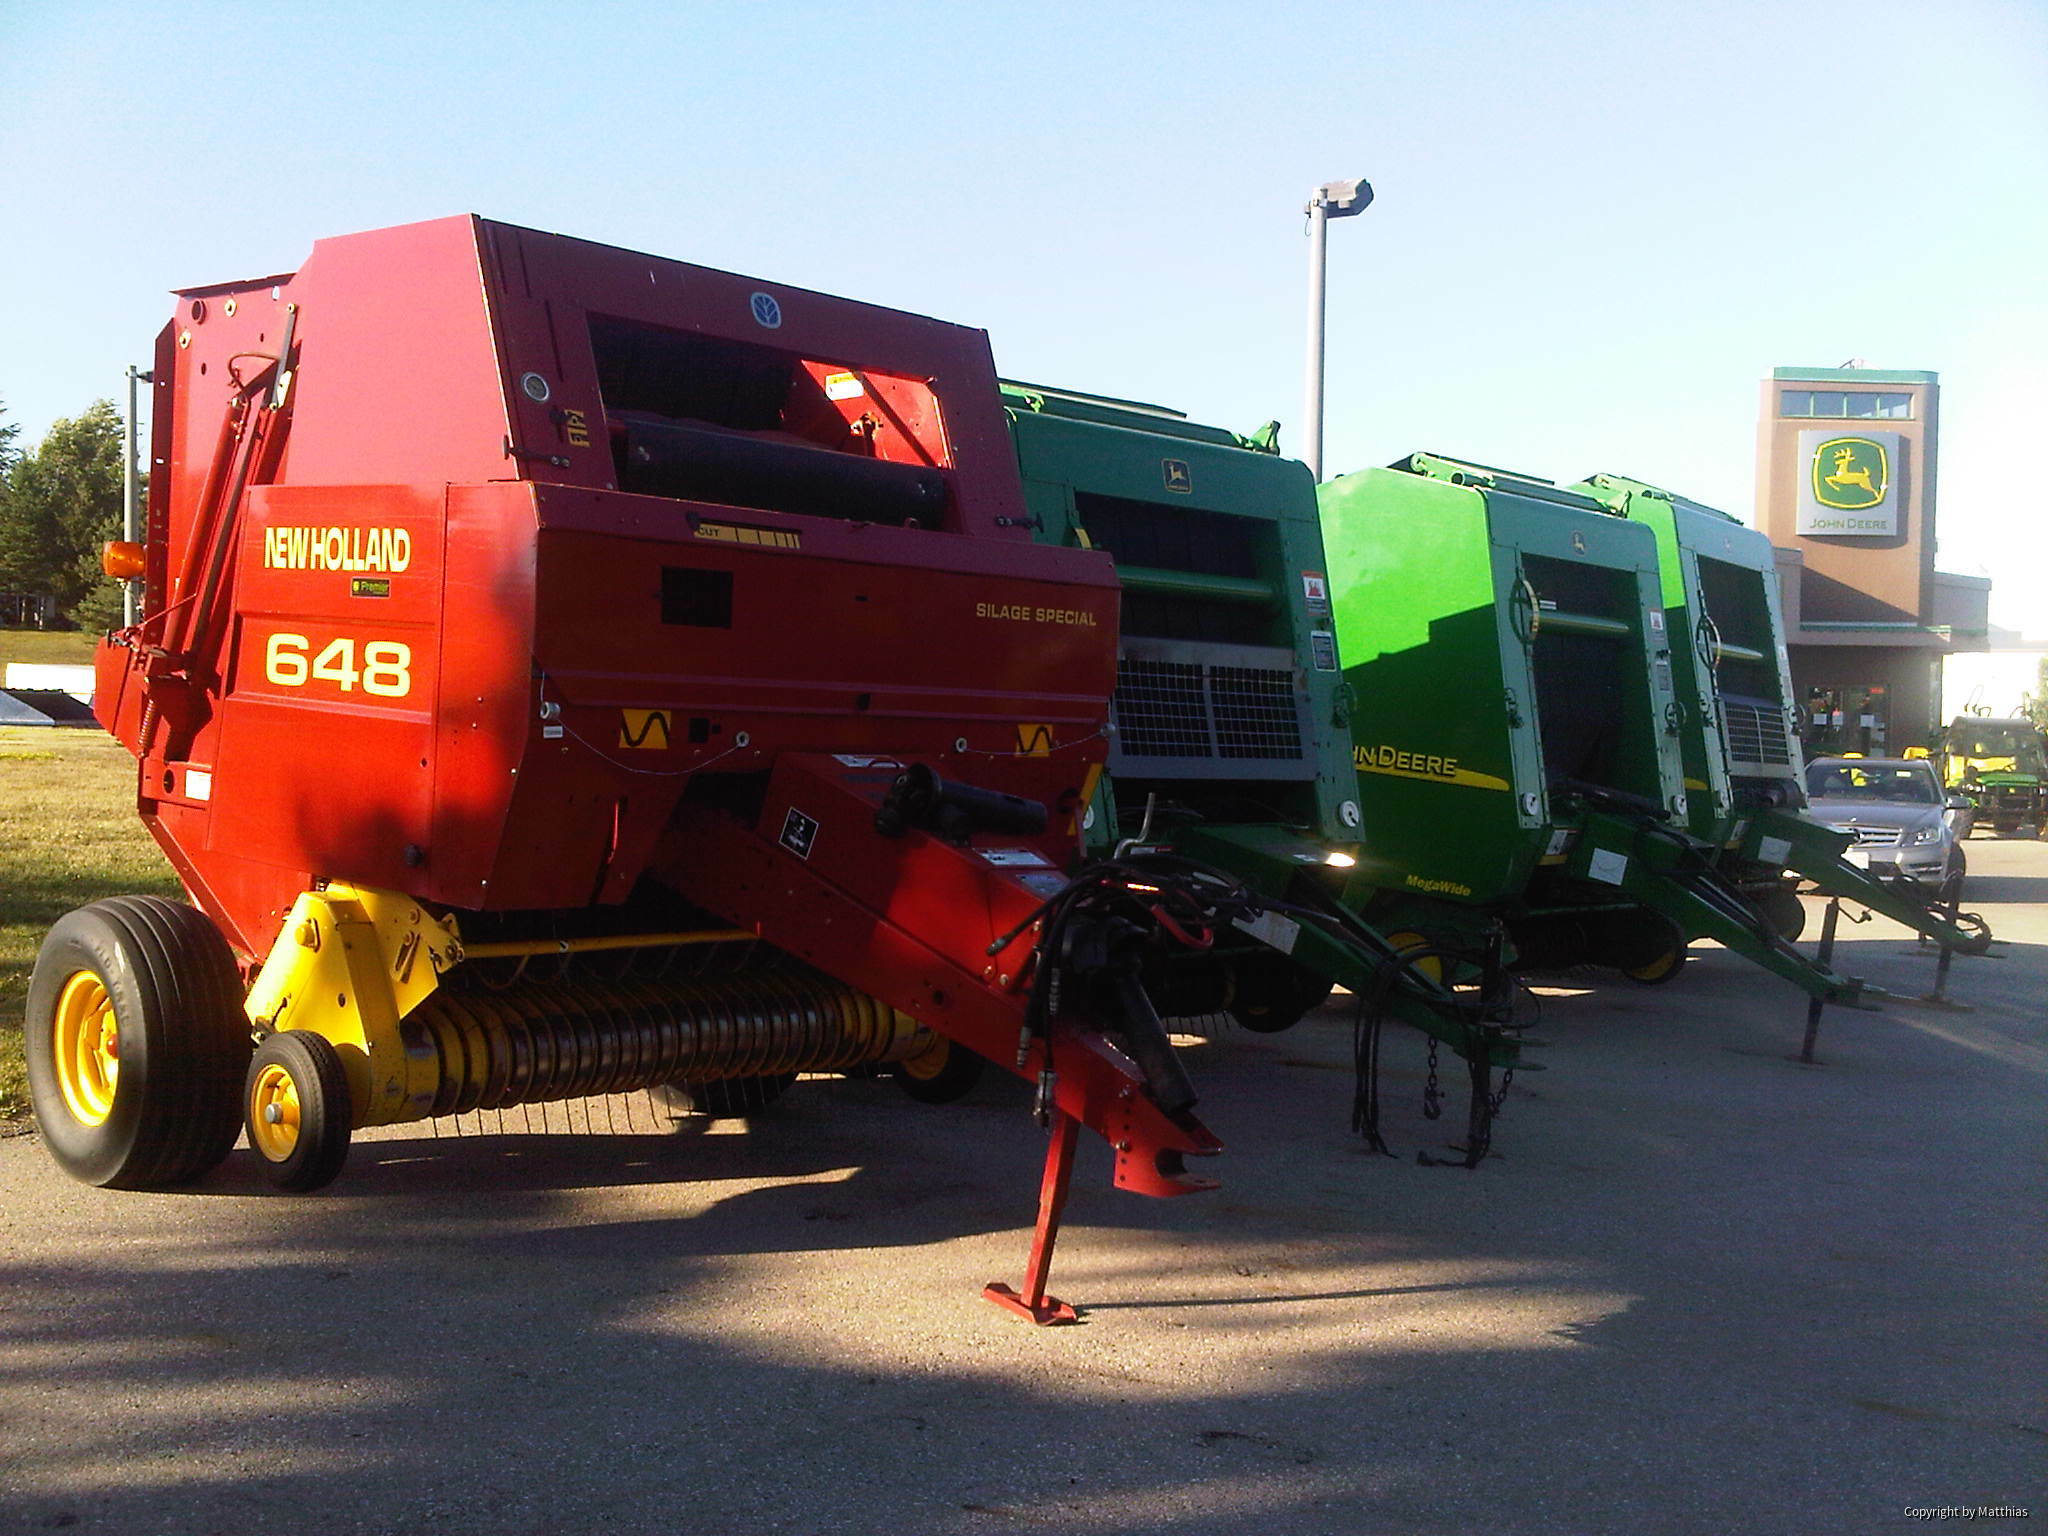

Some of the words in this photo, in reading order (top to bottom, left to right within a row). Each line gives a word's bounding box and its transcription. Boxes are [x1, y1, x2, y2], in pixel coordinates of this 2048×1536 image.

[1809, 518, 1845, 529] JOHN
[1847, 518, 1889, 529] DEERE
[264, 527, 309, 569] NEW
[310, 527, 411, 573] HOLLAND
[976, 602, 1031, 621] SILAGE
[1035, 607, 1097, 626] SPECIAL
[265, 632, 412, 698] 648
[1378, 744, 1458, 777] DEERE
[1407, 874, 1472, 896] MegaWide
